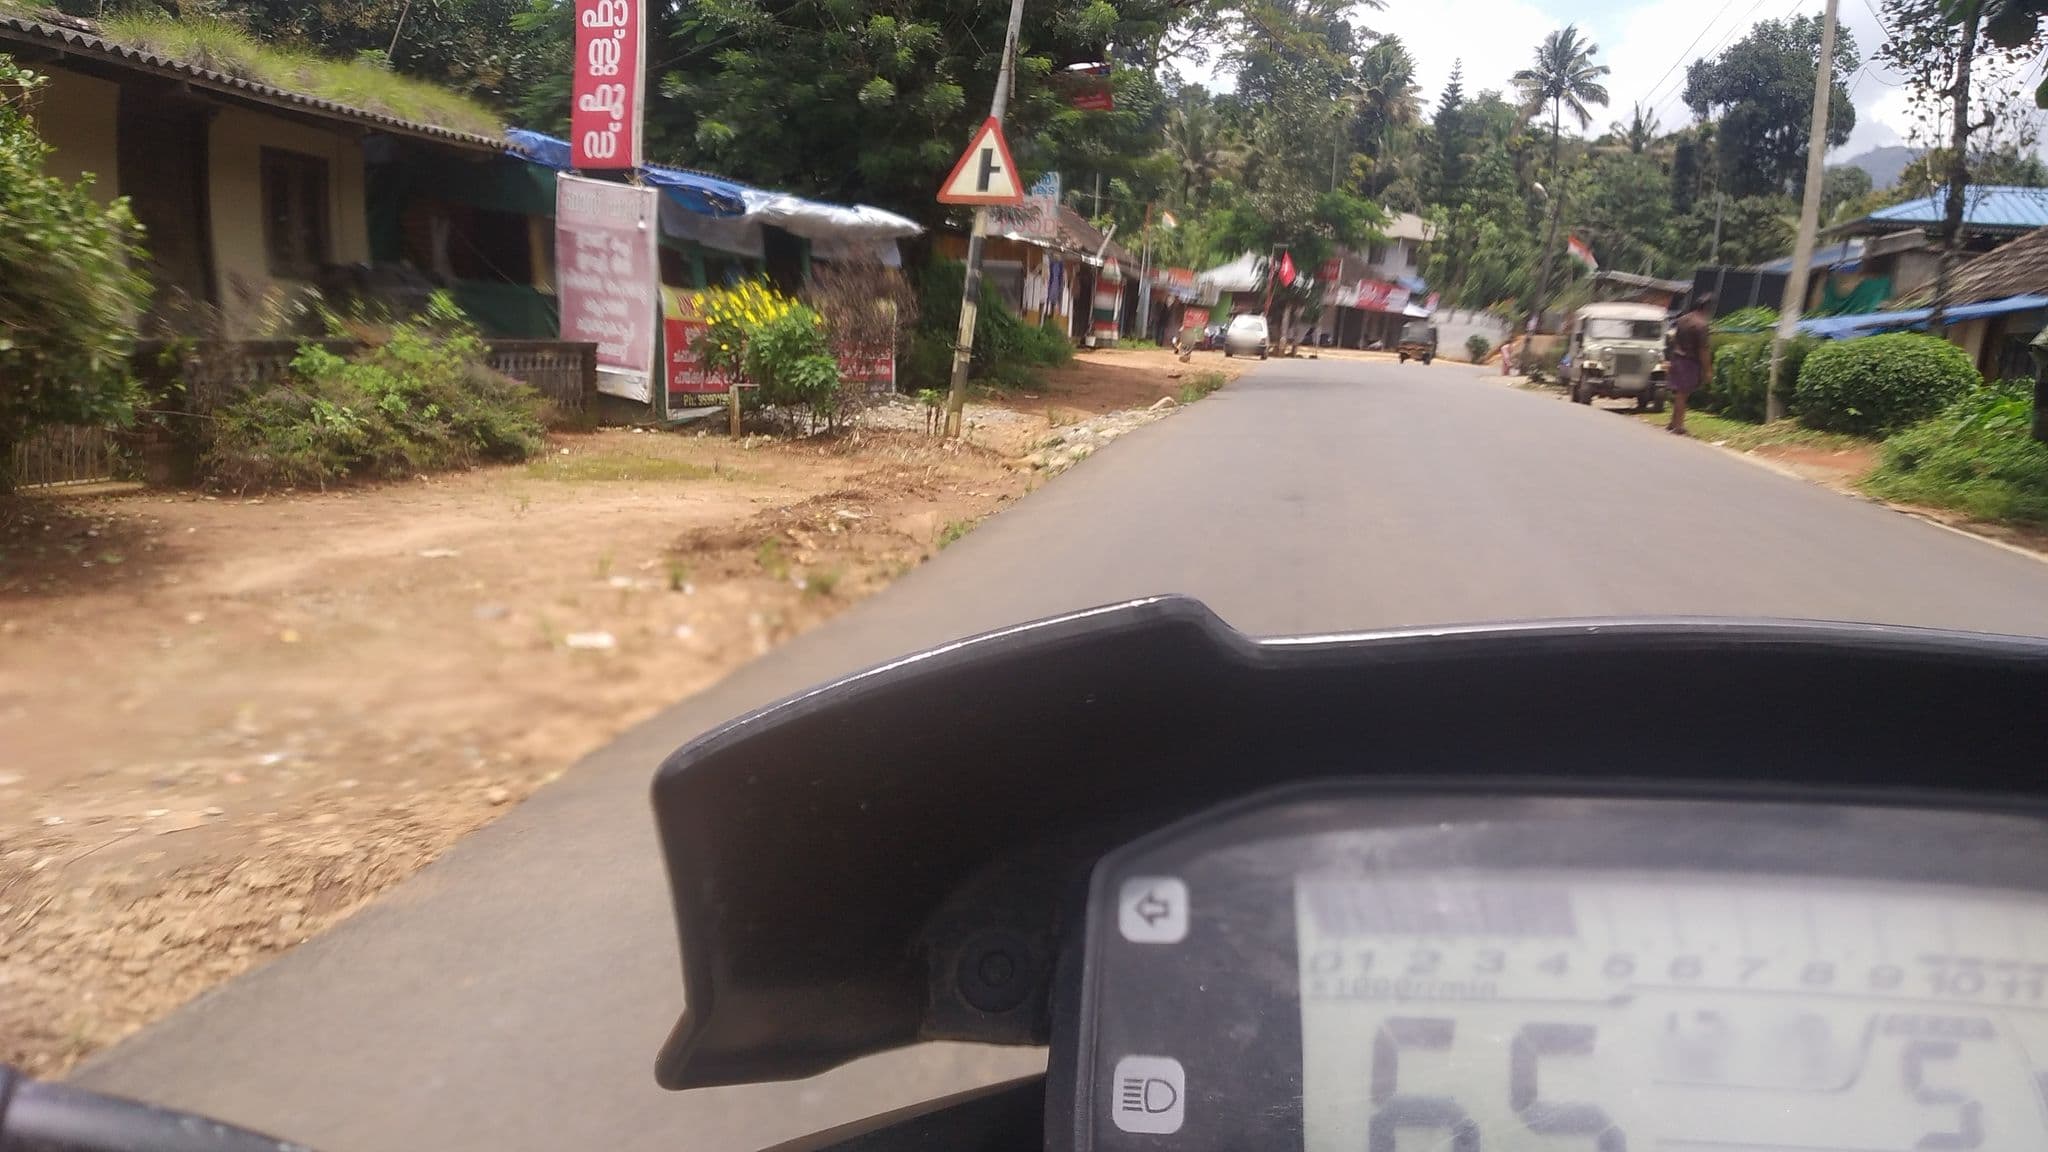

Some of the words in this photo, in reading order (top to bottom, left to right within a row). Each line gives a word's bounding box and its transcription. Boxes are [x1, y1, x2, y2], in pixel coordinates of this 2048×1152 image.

[1408, 950, 1442, 974] 2
[1474, 951, 1507, 974] 3
[1537, 952, 1571, 976] 4
[1602, 952, 1637, 978] 5
[1669, 954, 1704, 980] 6
[1737, 957, 1769, 982] 7
[1800, 961, 1836, 986] 8
[1868, 964, 1904, 989] 9
[1929, 969, 1984, 995] 10
[1998, 971, 2045, 1000] 11
[1367, 1017, 1627, 1152] 65
[1901, 1039, 1986, 1152] 5
